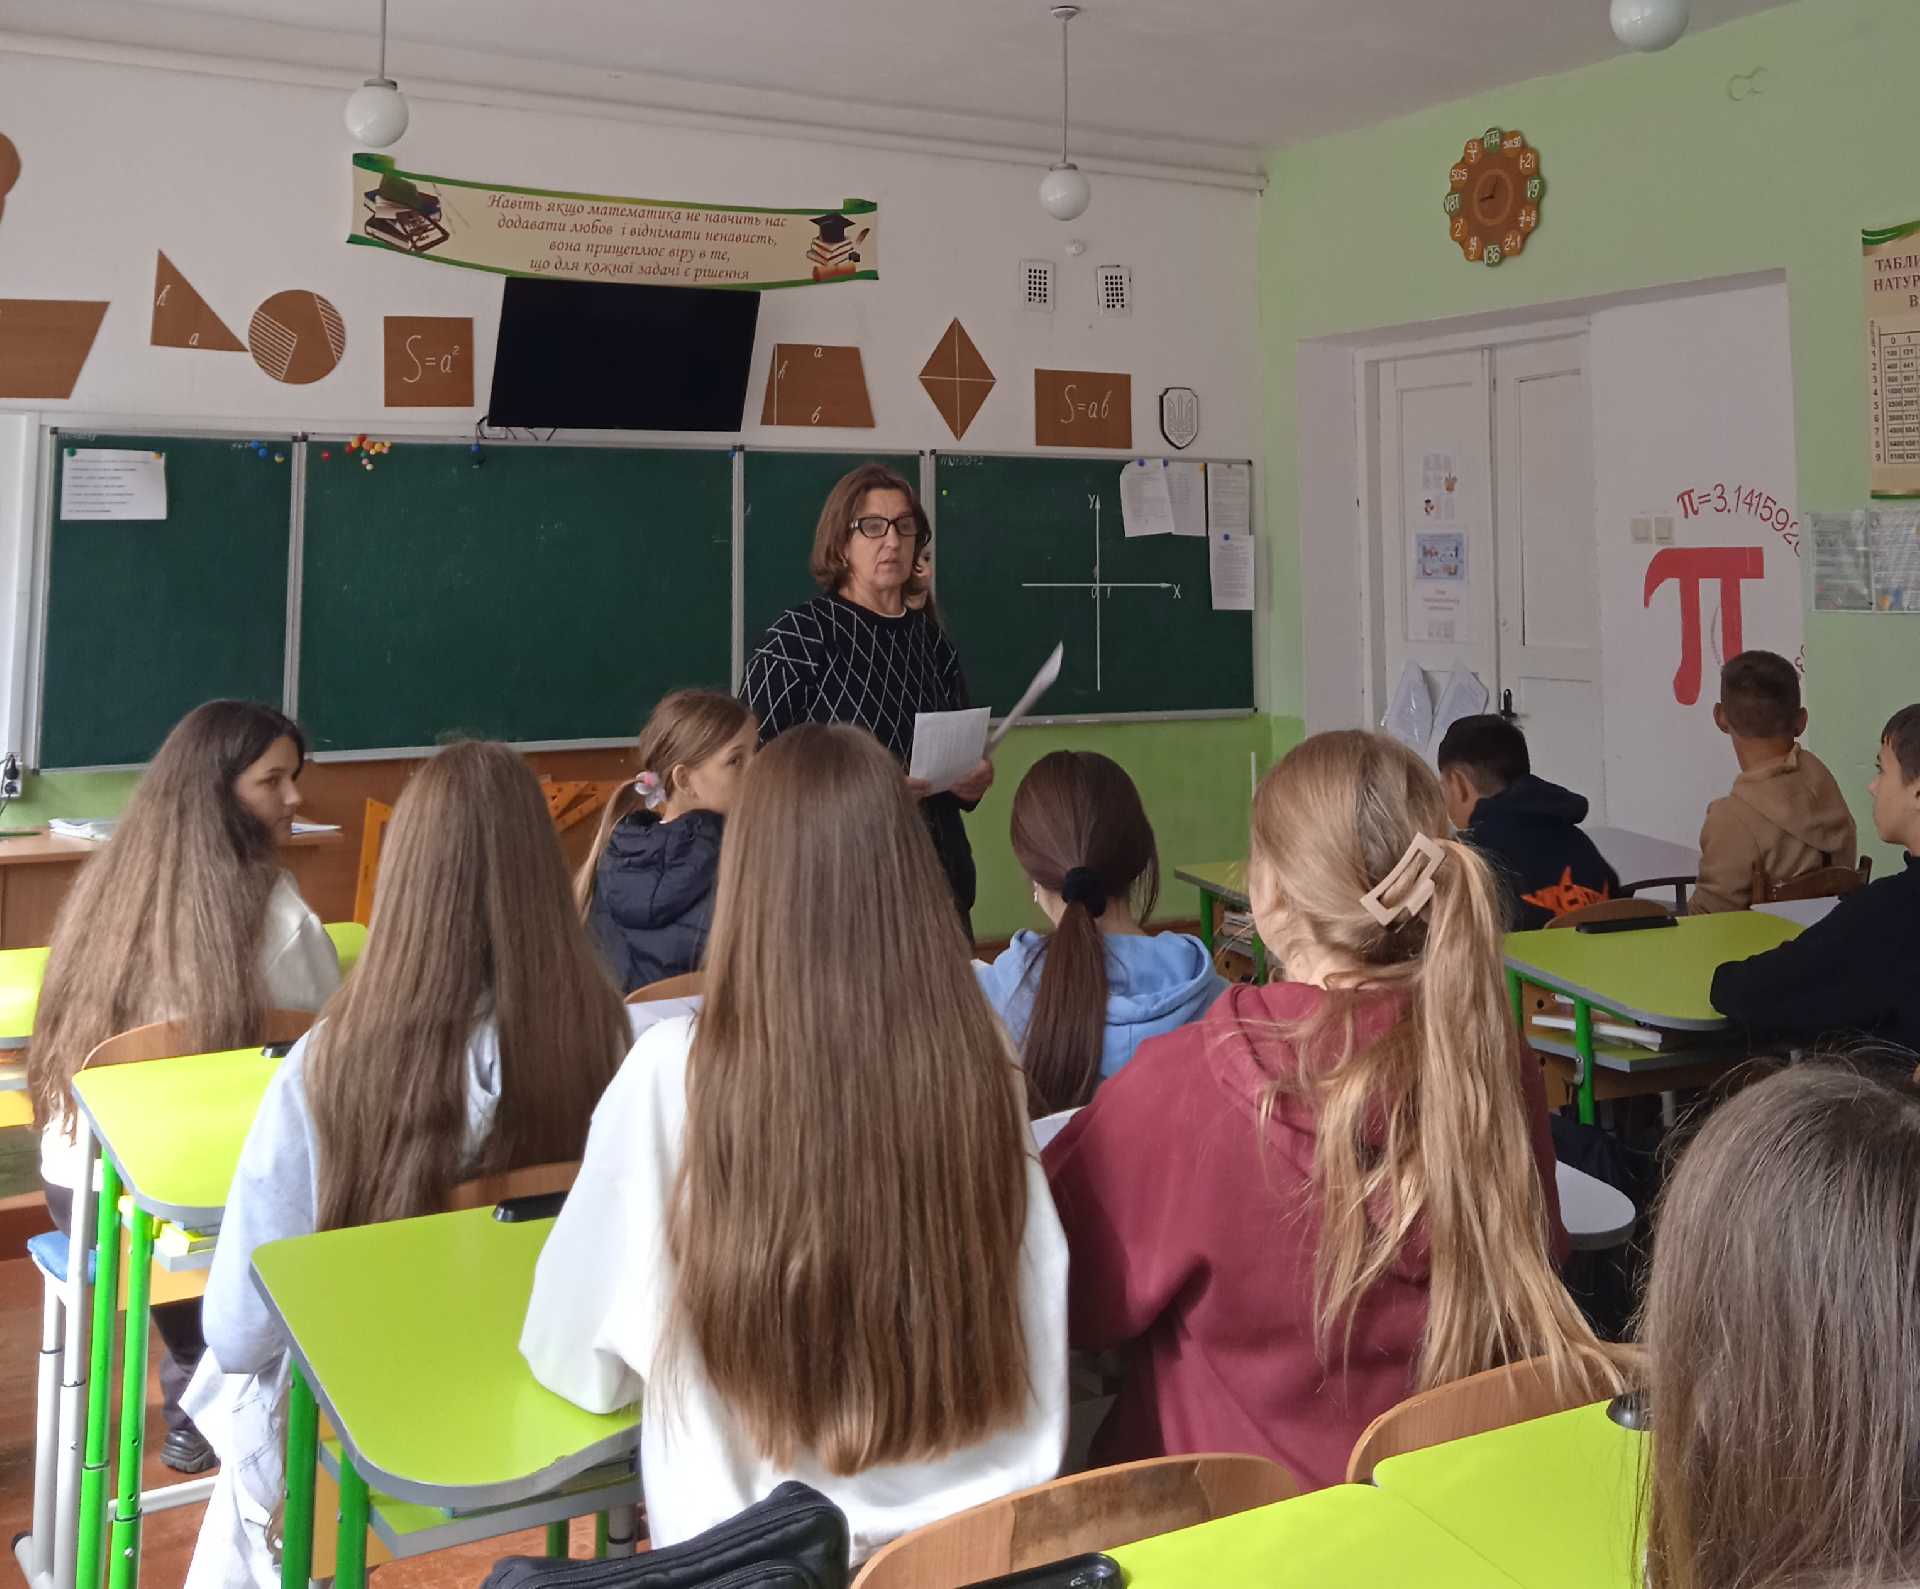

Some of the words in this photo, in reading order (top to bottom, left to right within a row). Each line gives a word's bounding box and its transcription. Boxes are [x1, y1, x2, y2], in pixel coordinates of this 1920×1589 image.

[488, 194, 542, 213] Навіть
[546, 202, 585, 217] якщо
[587, 205, 682, 224] математика
[686, 215, 701, 223] не
[704, 213, 761, 226] навчить
[765, 217, 788, 228] нас
[497, 213, 566, 233] додавати
[569, 219, 613, 235] любов
[629, 225, 701, 242] віднімати
[704, 230, 778, 247] ненависть,
[549, 240, 581, 253] вона
[586, 243, 666, 258] прищеплює
[668, 249, 695, 264] віру
[699, 251, 707, 259] в
[710, 250, 731, 262] те,
[530, 259, 550, 272] що
[554, 256, 581, 272] для
[583, 262, 633, 275] кожної
[638, 263, 681, 278] задачі
[693, 266, 750, 281] рішення
